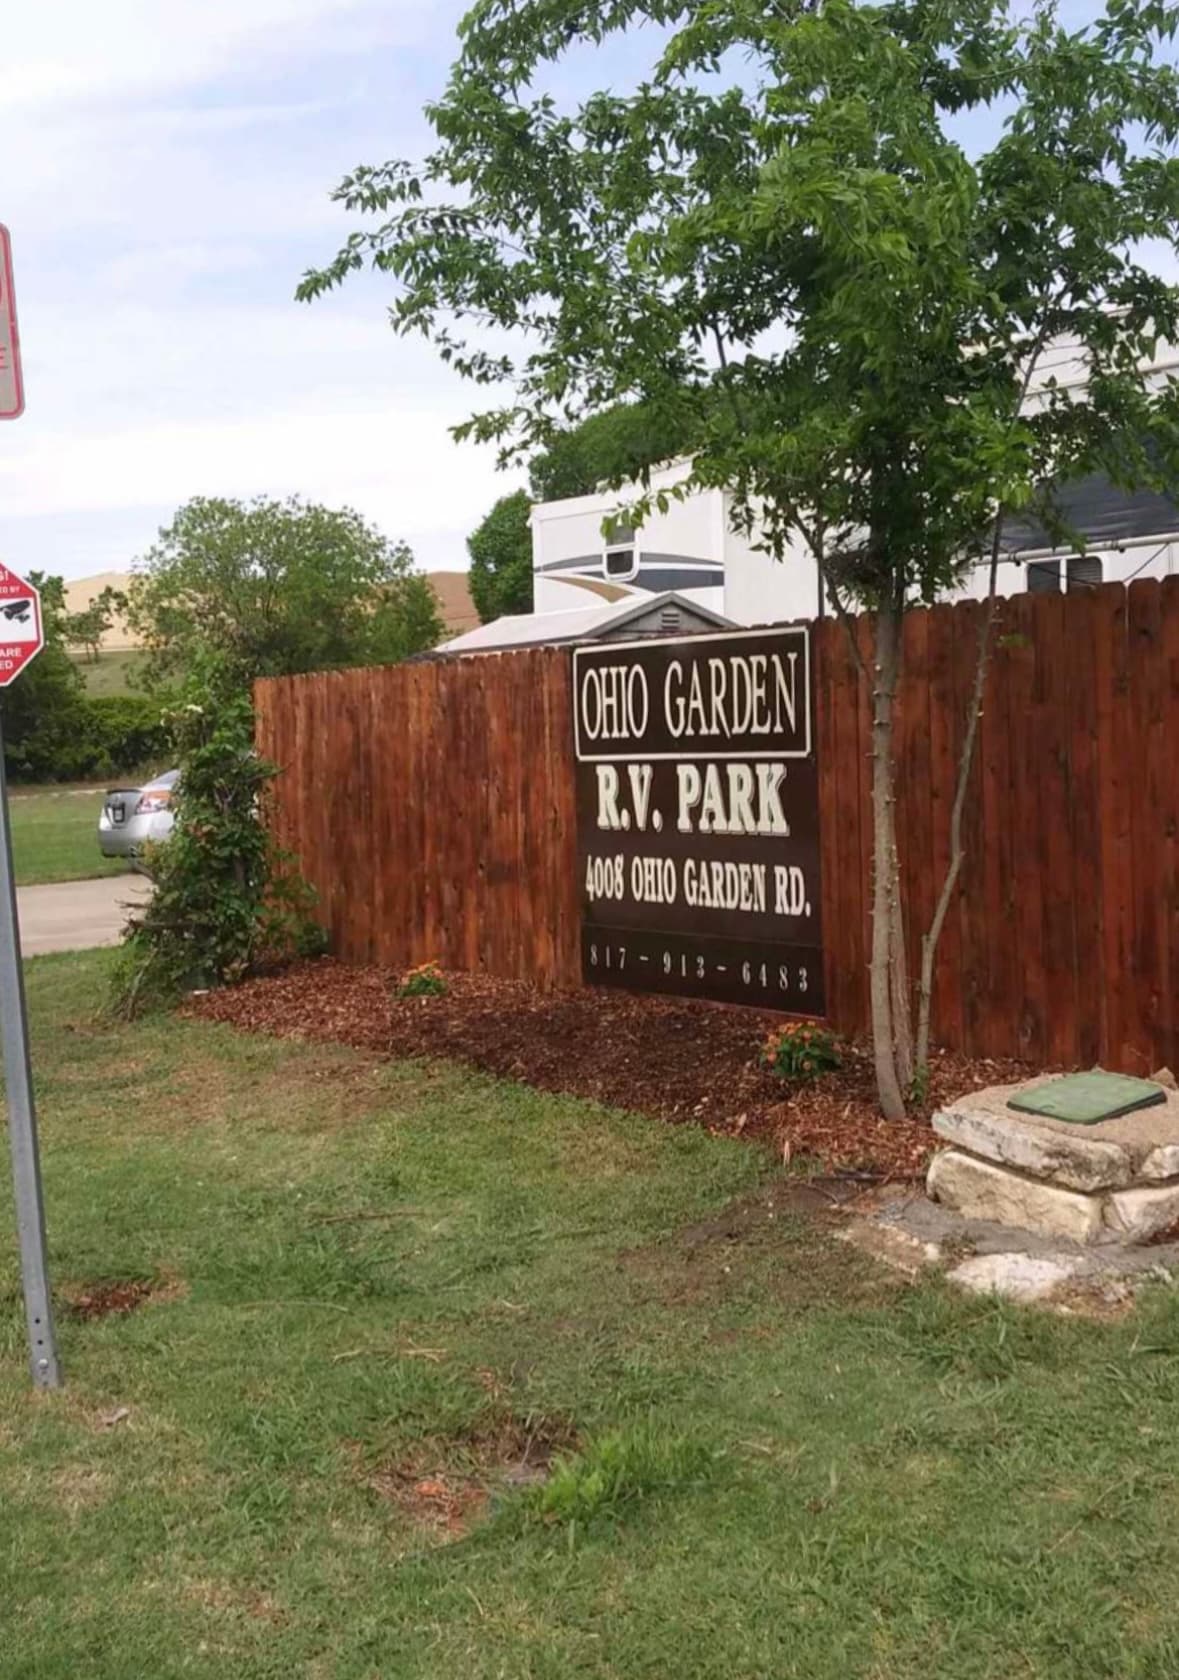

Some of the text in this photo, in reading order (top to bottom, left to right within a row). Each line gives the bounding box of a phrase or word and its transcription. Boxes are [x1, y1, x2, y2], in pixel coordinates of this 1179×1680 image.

[581, 652, 798, 740] OHIO GARDEN
[595, 763, 790, 836] R.V. PARK
[586, 854, 811, 917] 4008 OHIO GARDEN RD.
